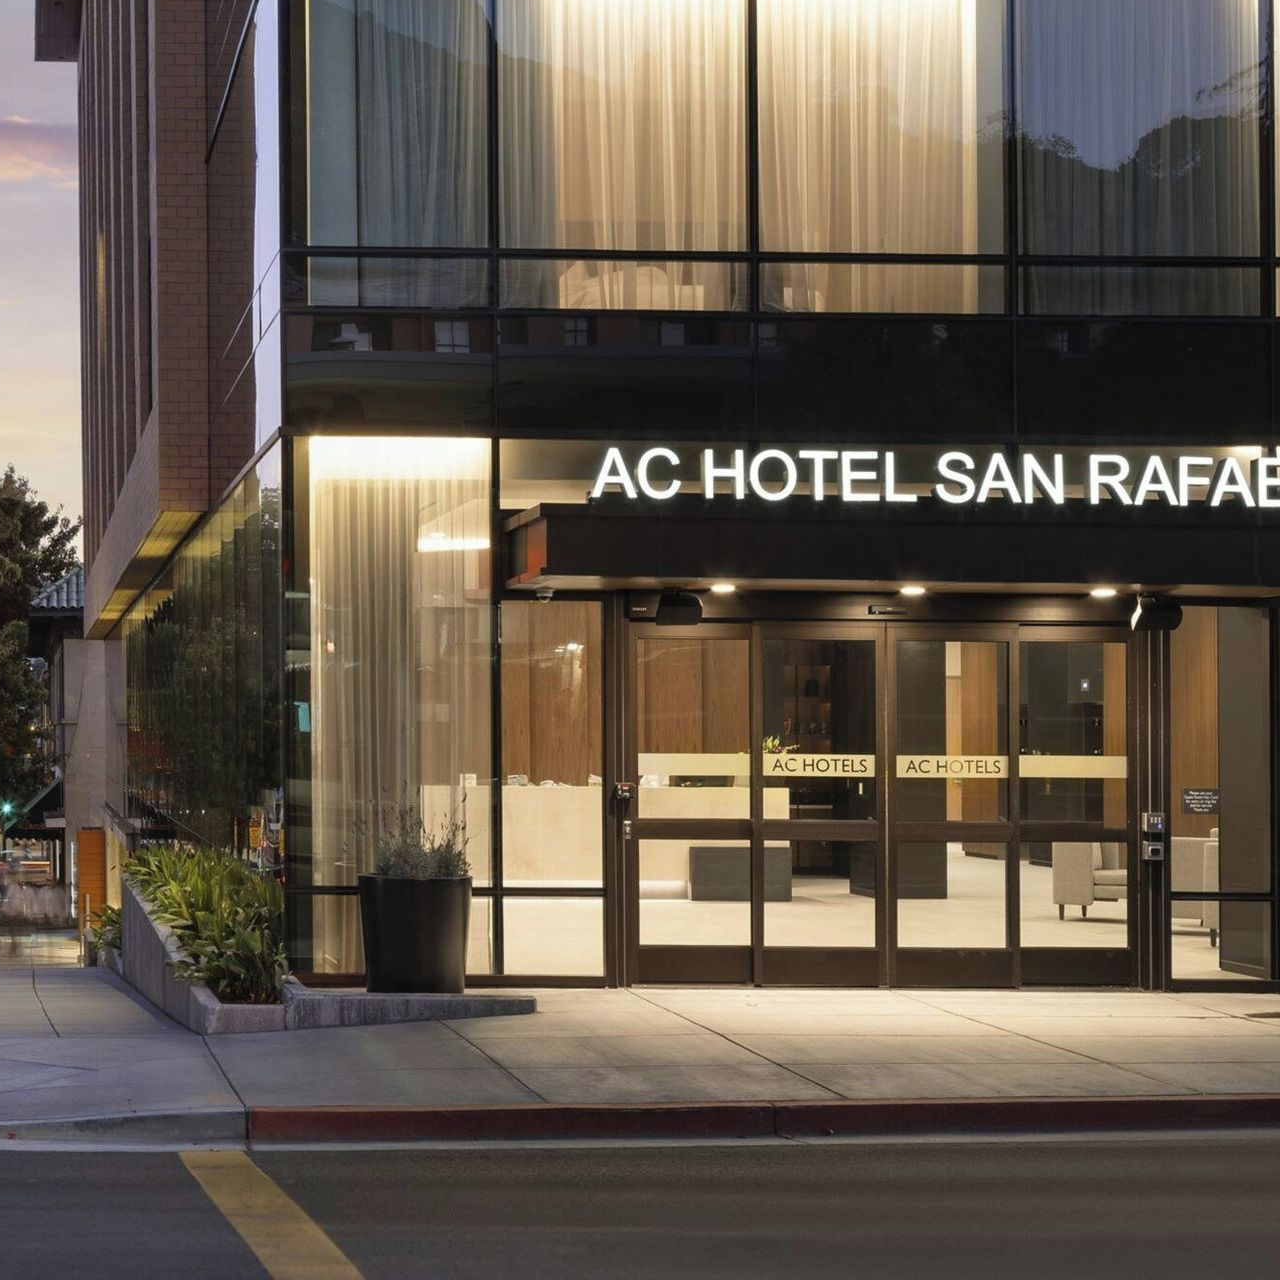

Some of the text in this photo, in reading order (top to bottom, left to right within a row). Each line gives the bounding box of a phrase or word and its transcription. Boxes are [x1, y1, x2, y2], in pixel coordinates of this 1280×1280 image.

[591, 446, 682, 500] AC
[702, 447, 918, 503] HOTEL
[934, 450, 1064, 505] SAN
[772, 758, 867, 773] AC HOTELS
[905, 759, 1001, 774] AC HOTELS
